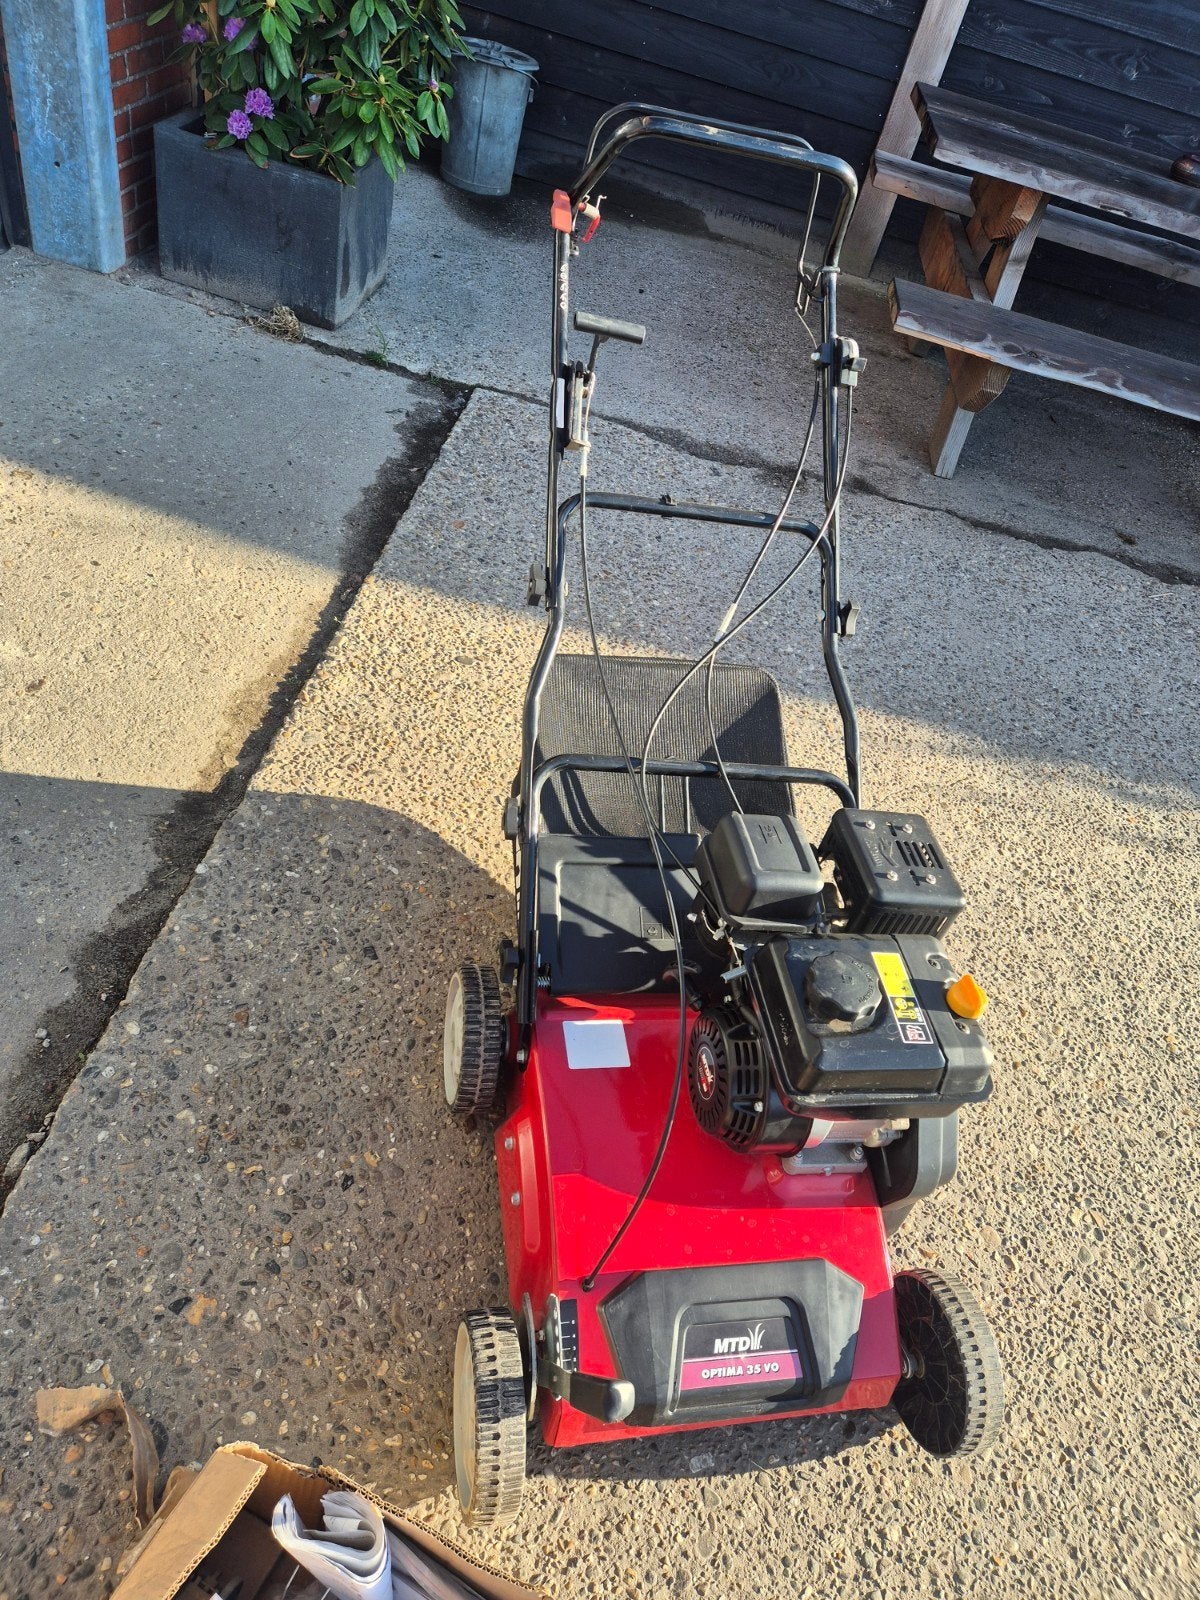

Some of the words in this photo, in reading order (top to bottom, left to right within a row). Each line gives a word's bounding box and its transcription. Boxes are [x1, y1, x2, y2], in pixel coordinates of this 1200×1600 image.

[714, 1336, 751, 1354] MTD
[701, 1364, 744, 1379] OPTIMA
[746, 1363, 761, 1375] 35
[763, 1361, 780, 1373] VO
